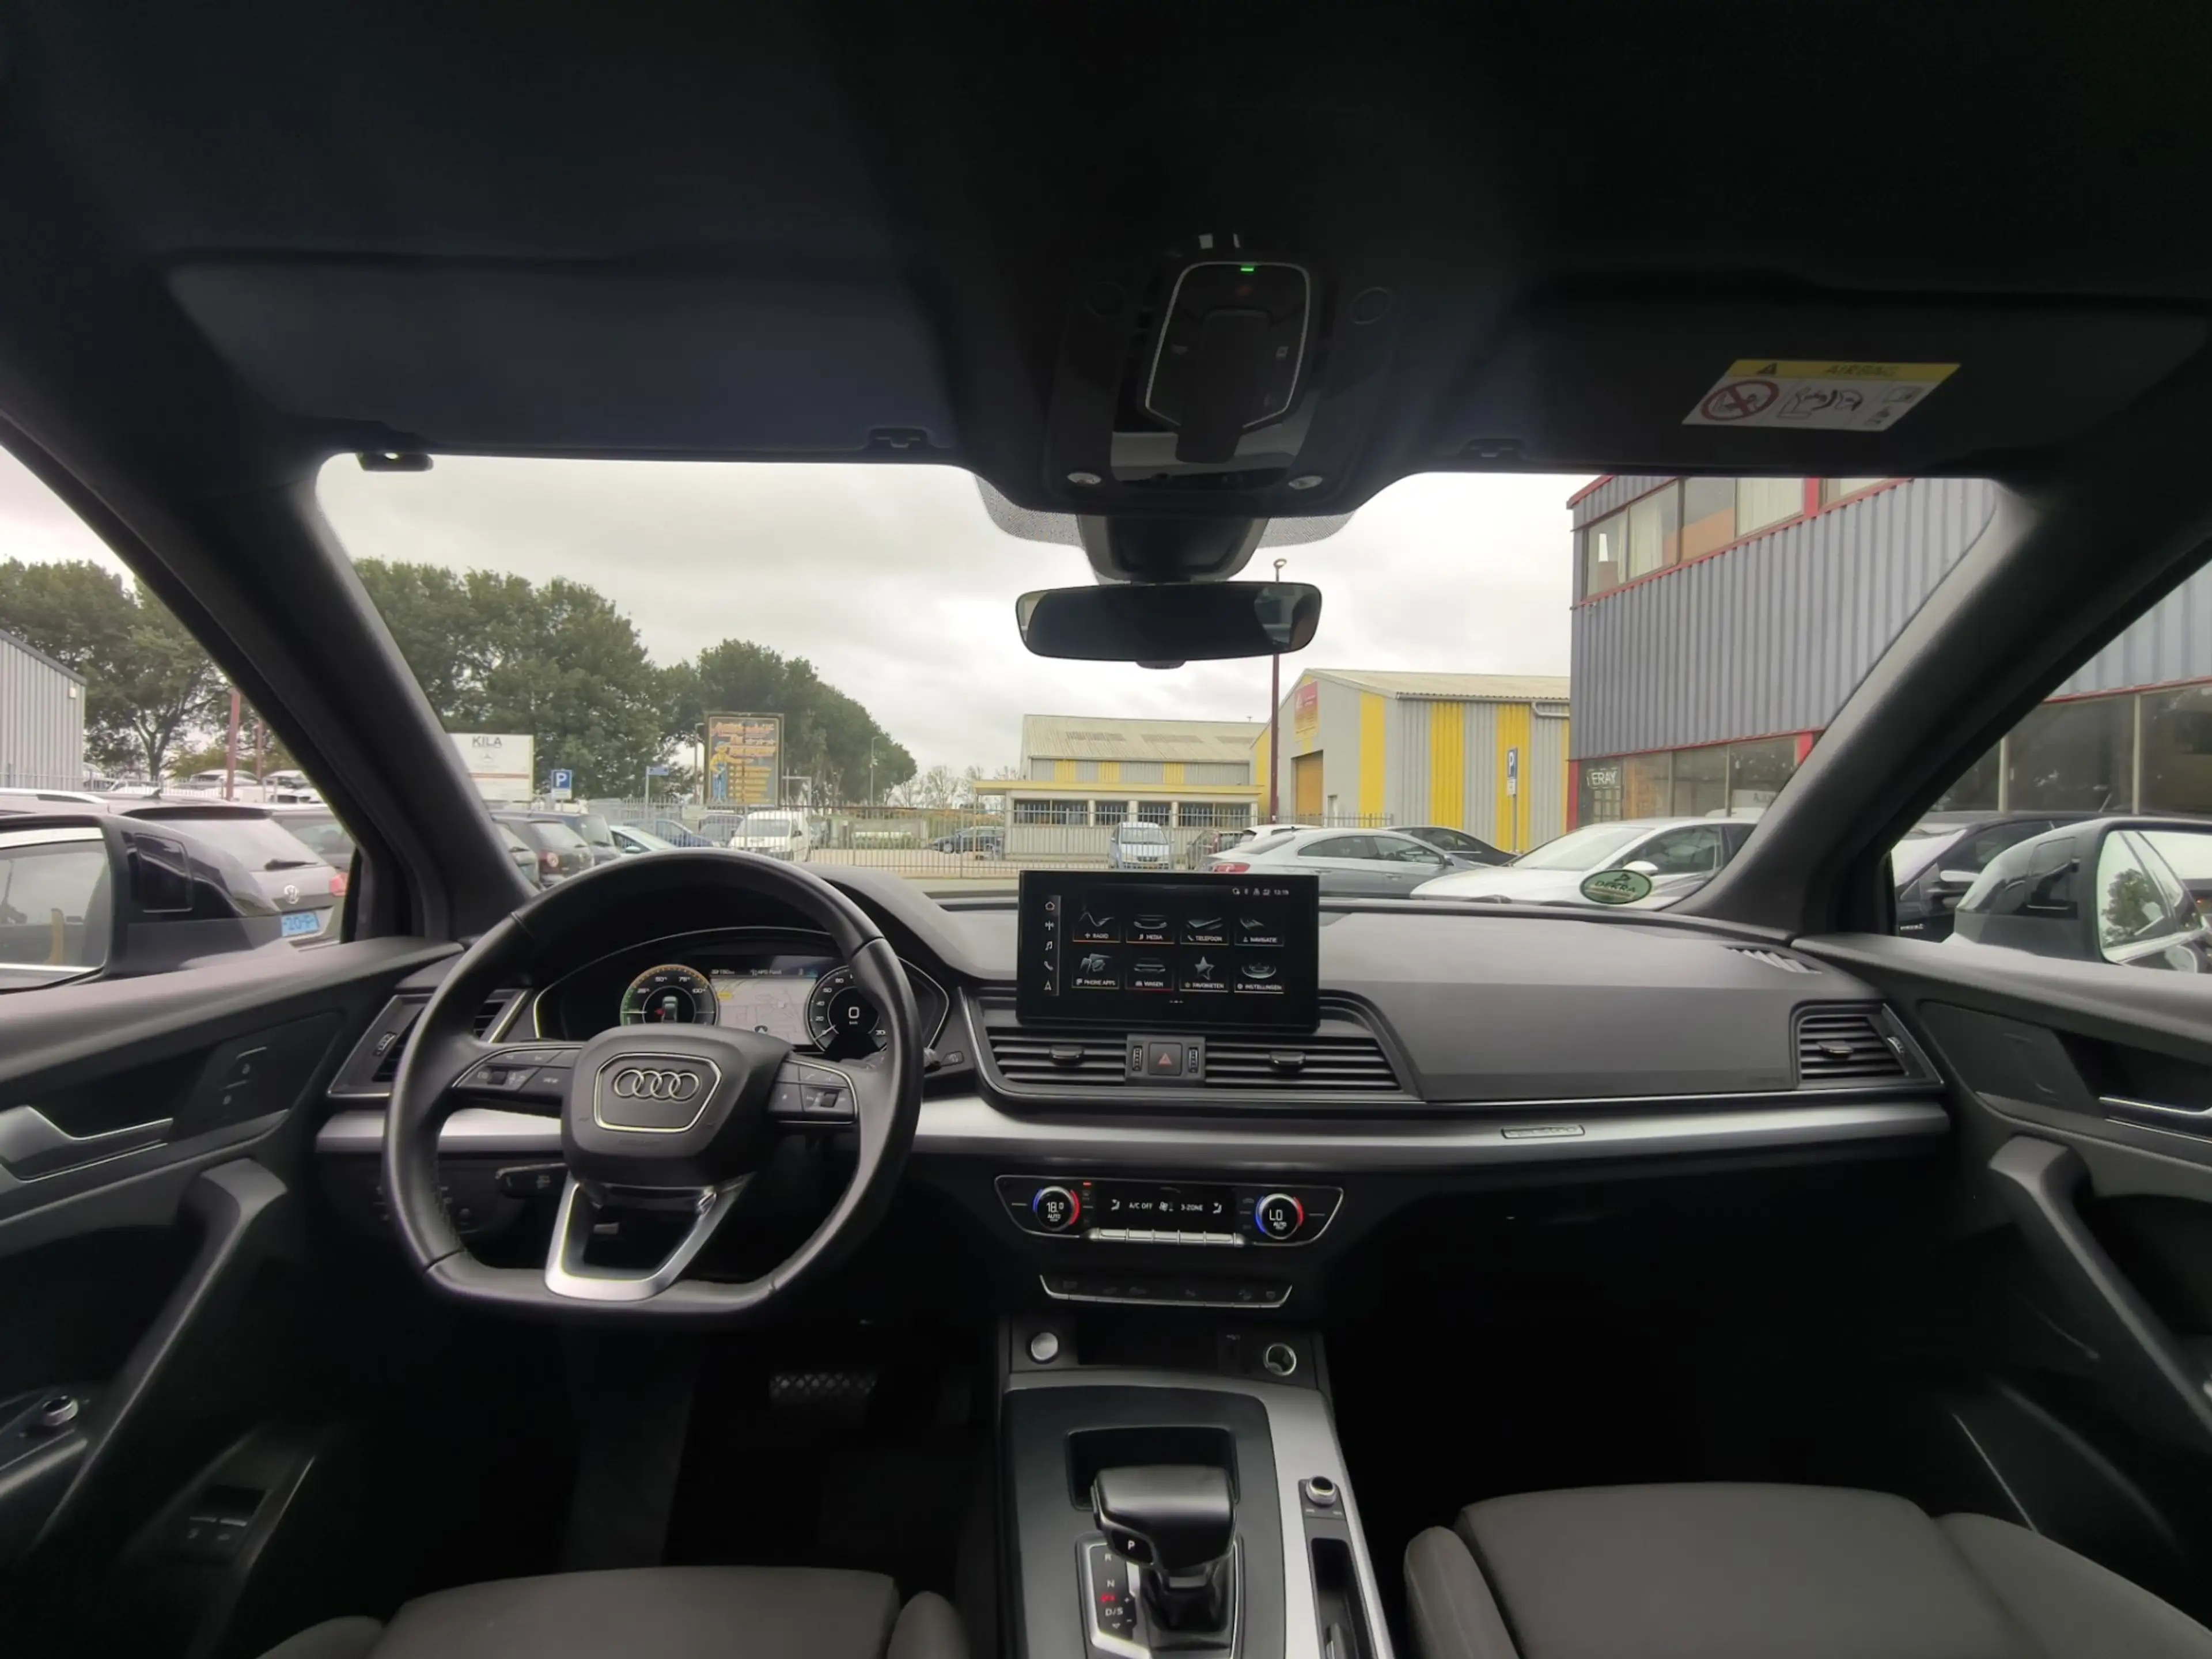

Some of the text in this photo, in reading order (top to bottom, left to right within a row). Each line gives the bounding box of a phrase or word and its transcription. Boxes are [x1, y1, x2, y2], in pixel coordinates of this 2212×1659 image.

[472, 736, 502, 748] KILA
[555, 772, 567, 787] P
[1591, 771, 1618, 785] ERAY
[1594, 880, 1637, 892] DEKRA
[848, 1006, 860, 1020] 0
[1269, 1209, 1283, 1221] LO
[1127, 1540, 1135, 1550] P
[1105, 1554, 1112, 1562] R
[1107, 1580, 1115, 1588] N
[1105, 1607, 1123, 1616] D/S
